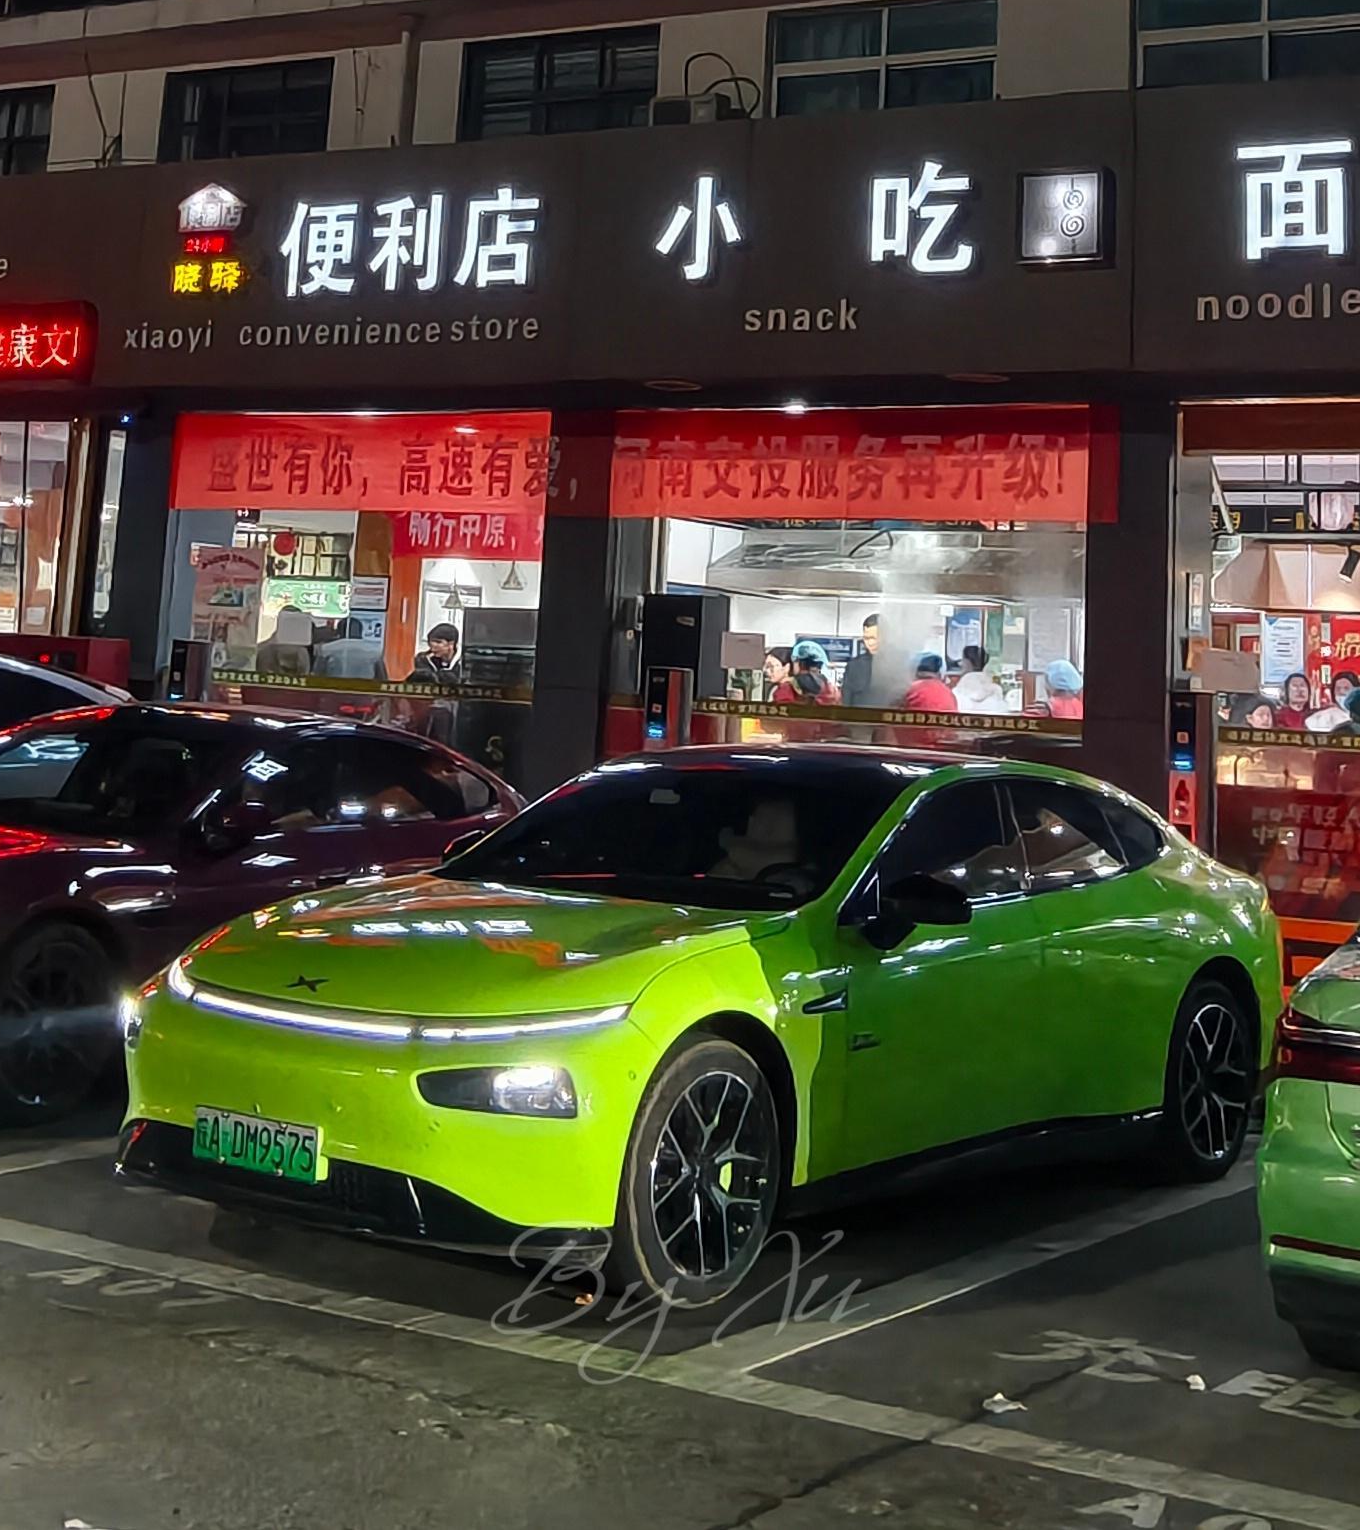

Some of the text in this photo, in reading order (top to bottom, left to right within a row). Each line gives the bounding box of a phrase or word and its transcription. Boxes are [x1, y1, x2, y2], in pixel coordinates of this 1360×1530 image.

[280, 186, 540, 298] 便利店
[655, 160, 973, 281] 小吃
[124, 314, 539, 354] xiaoyi convenience store
[744, 297, 860, 332] snack
